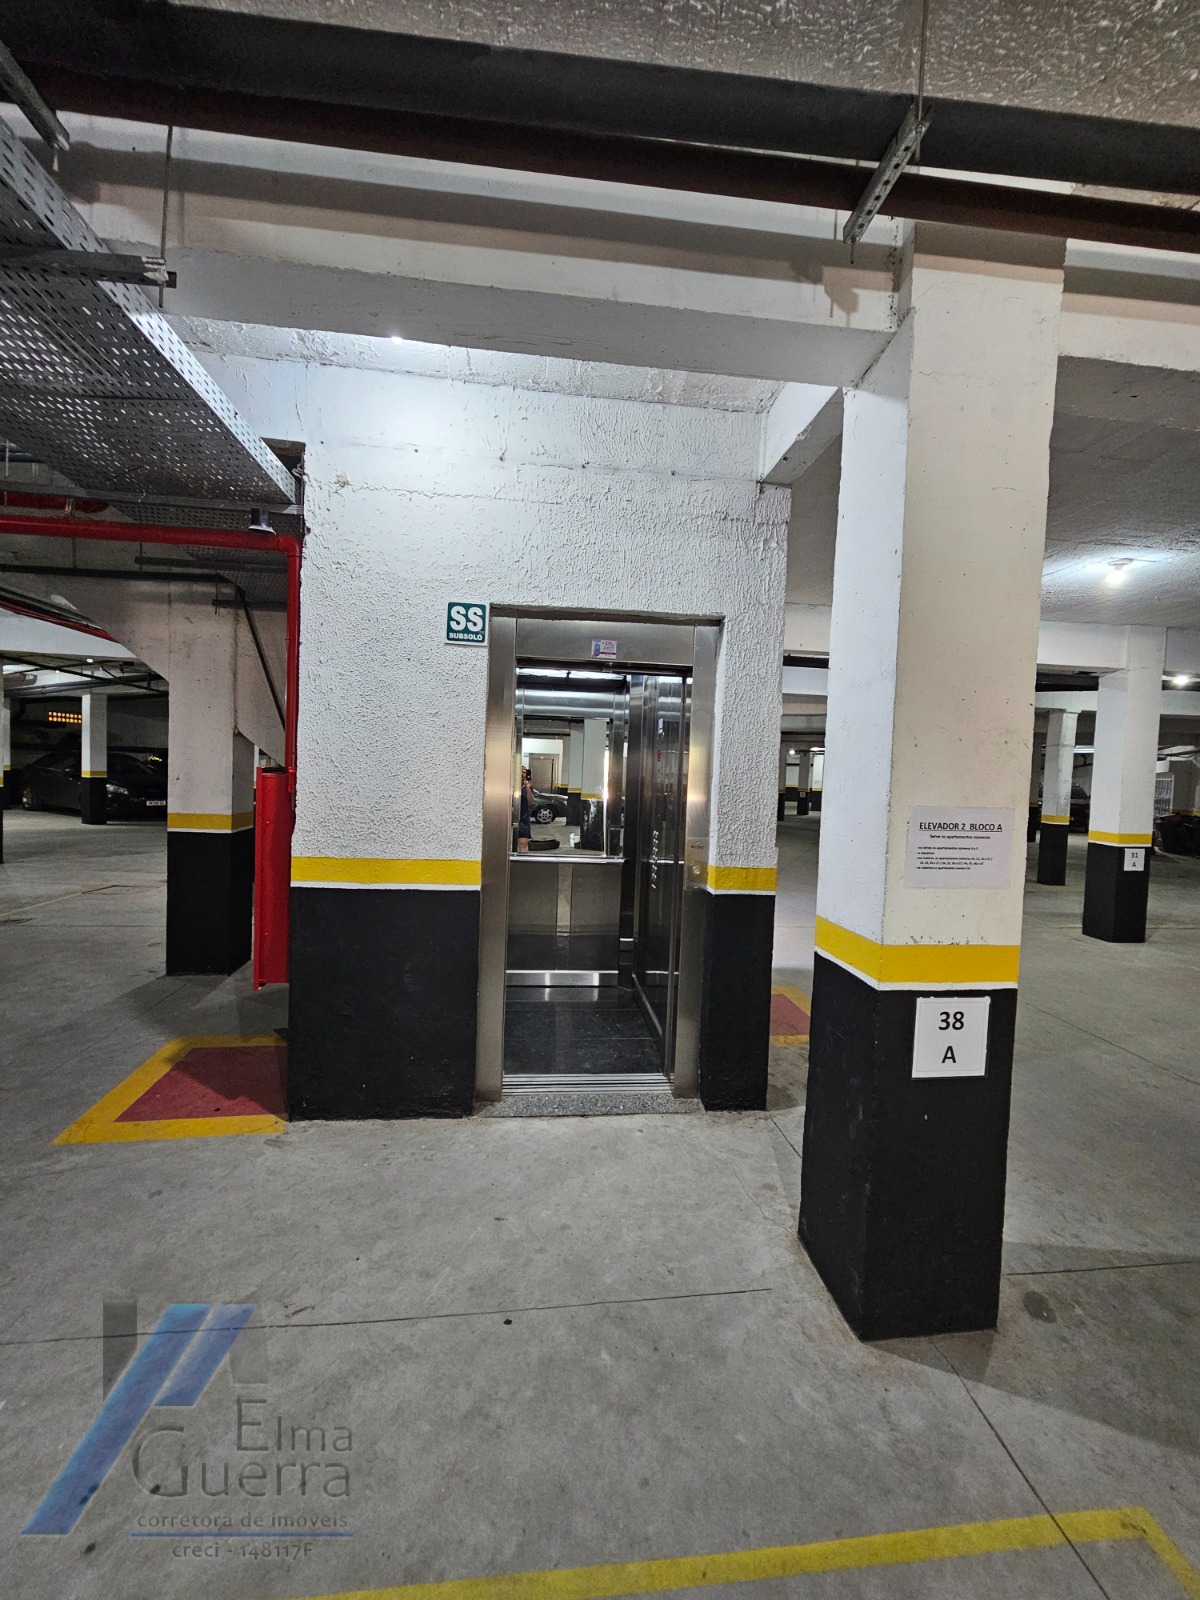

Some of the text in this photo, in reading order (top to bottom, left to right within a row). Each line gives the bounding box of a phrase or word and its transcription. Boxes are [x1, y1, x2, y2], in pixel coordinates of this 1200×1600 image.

[450, 605, 484, 632] SS
[449, 632, 483, 640] SUBSOLO
[919, 822, 1003, 831] ELEVADOR 2 BLOCO A
[938, 1011, 965, 1031] 38
[941, 1045, 957, 1064] A
